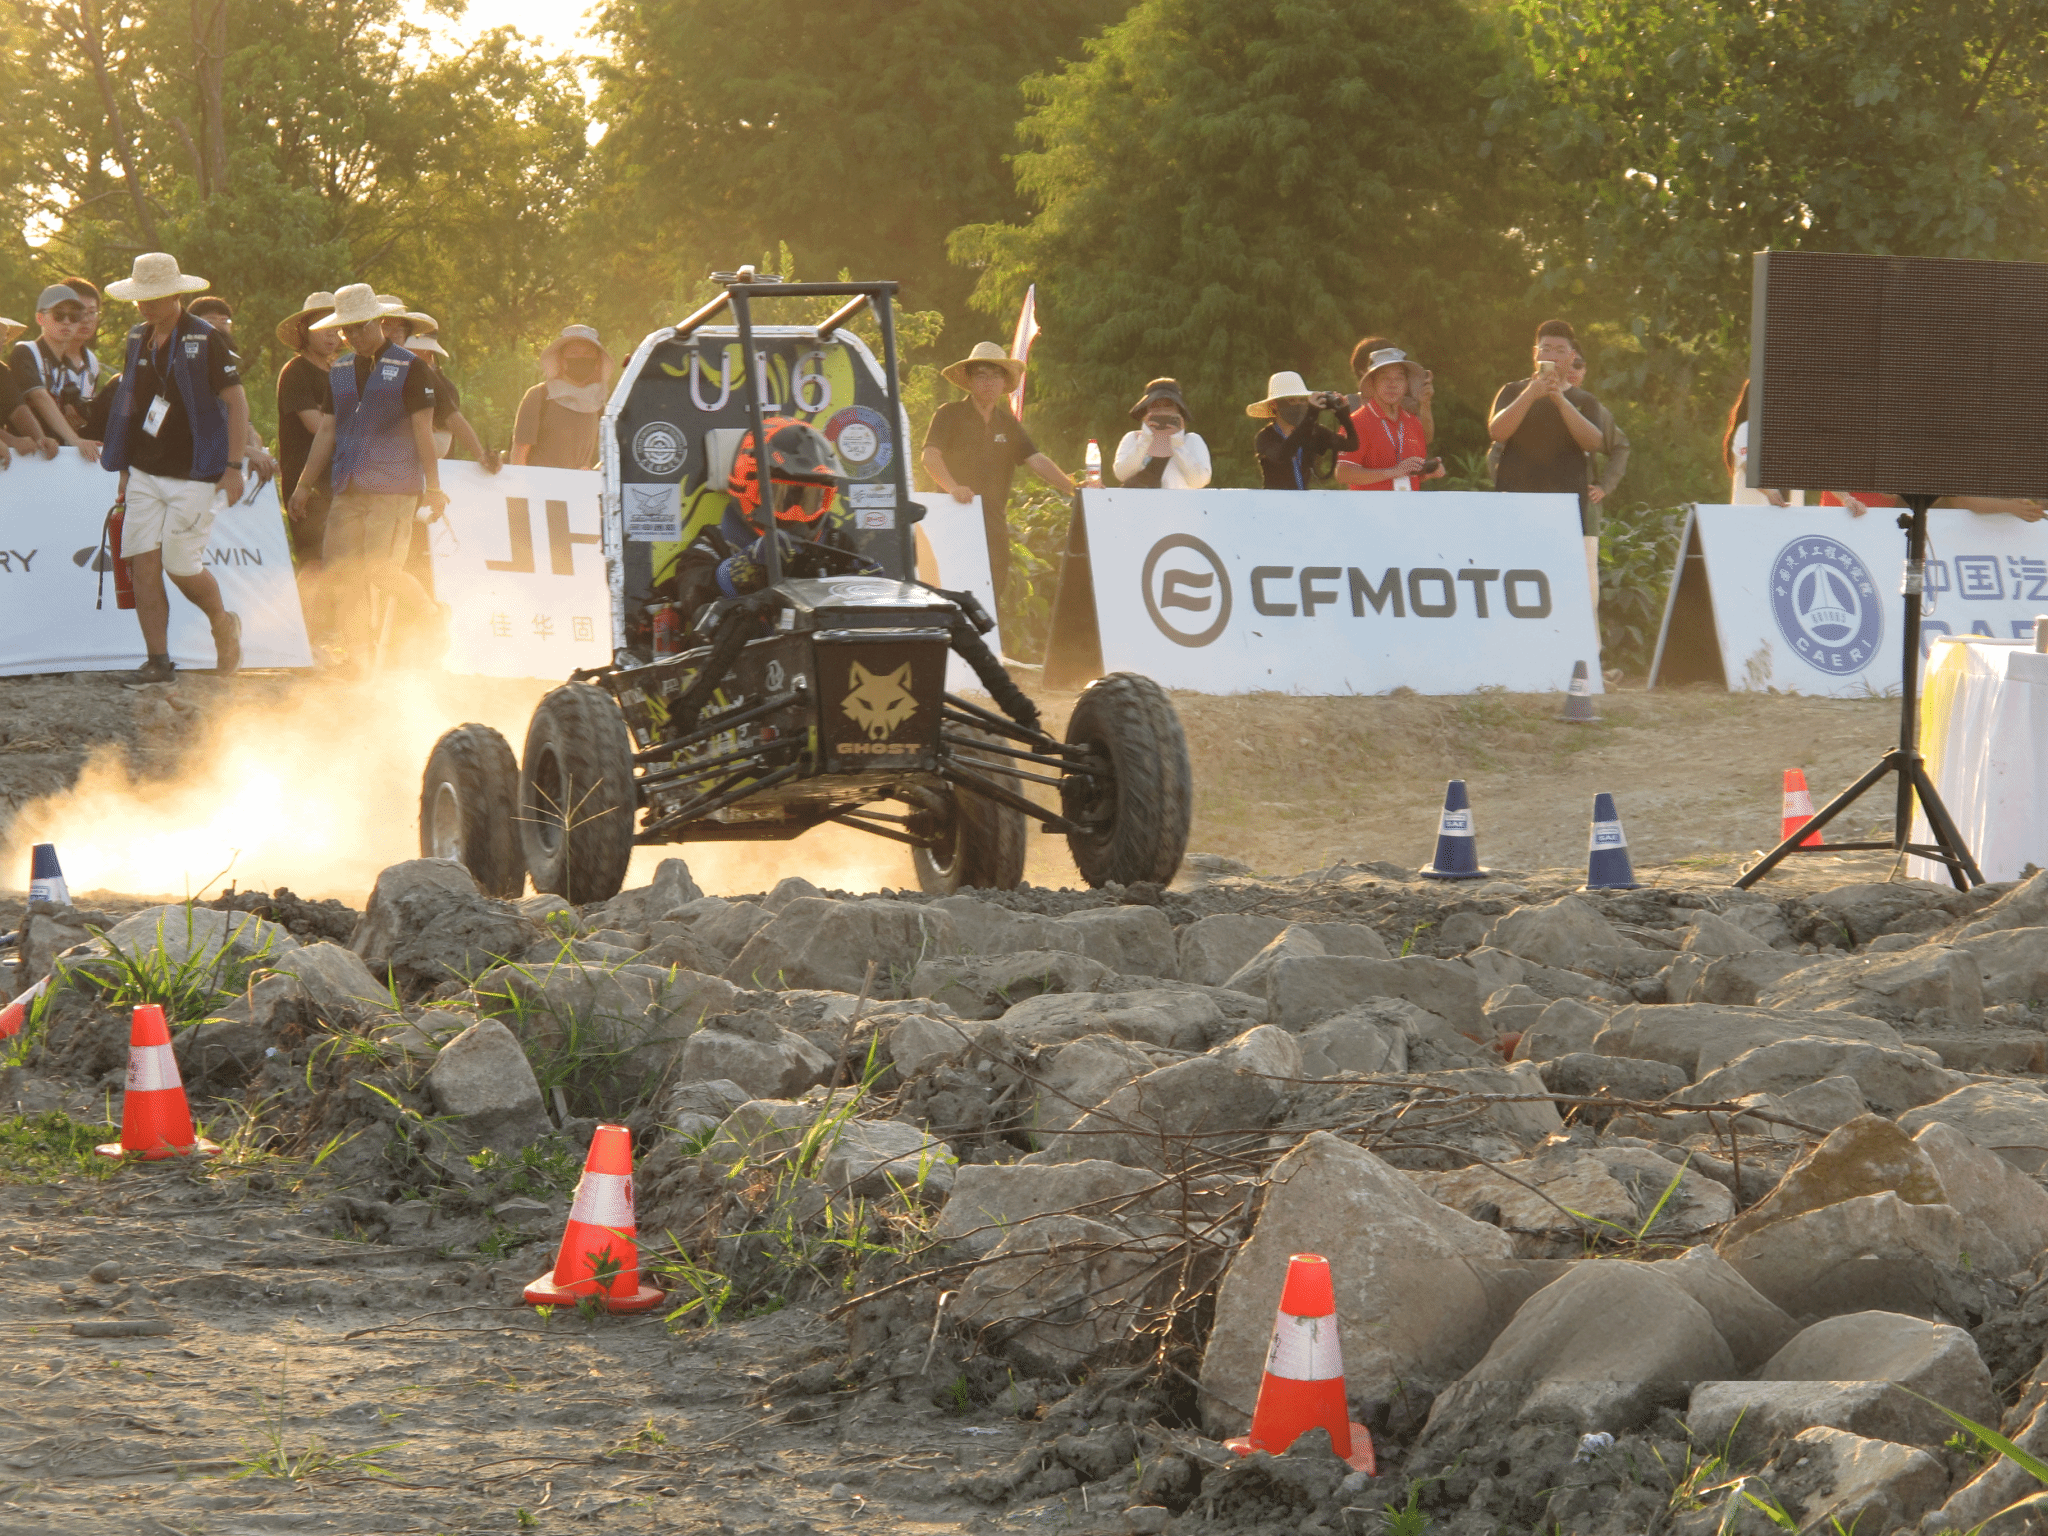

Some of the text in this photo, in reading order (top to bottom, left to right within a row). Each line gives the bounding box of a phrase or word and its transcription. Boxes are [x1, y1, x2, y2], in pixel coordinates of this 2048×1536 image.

[690, 350, 832, 413] U16
[202, 548, 263, 566] WIN
[1250, 565, 1552, 619] CFMOTO
[1796, 636, 1872, 667] CAERI
[836, 742, 921, 755] GHOST
